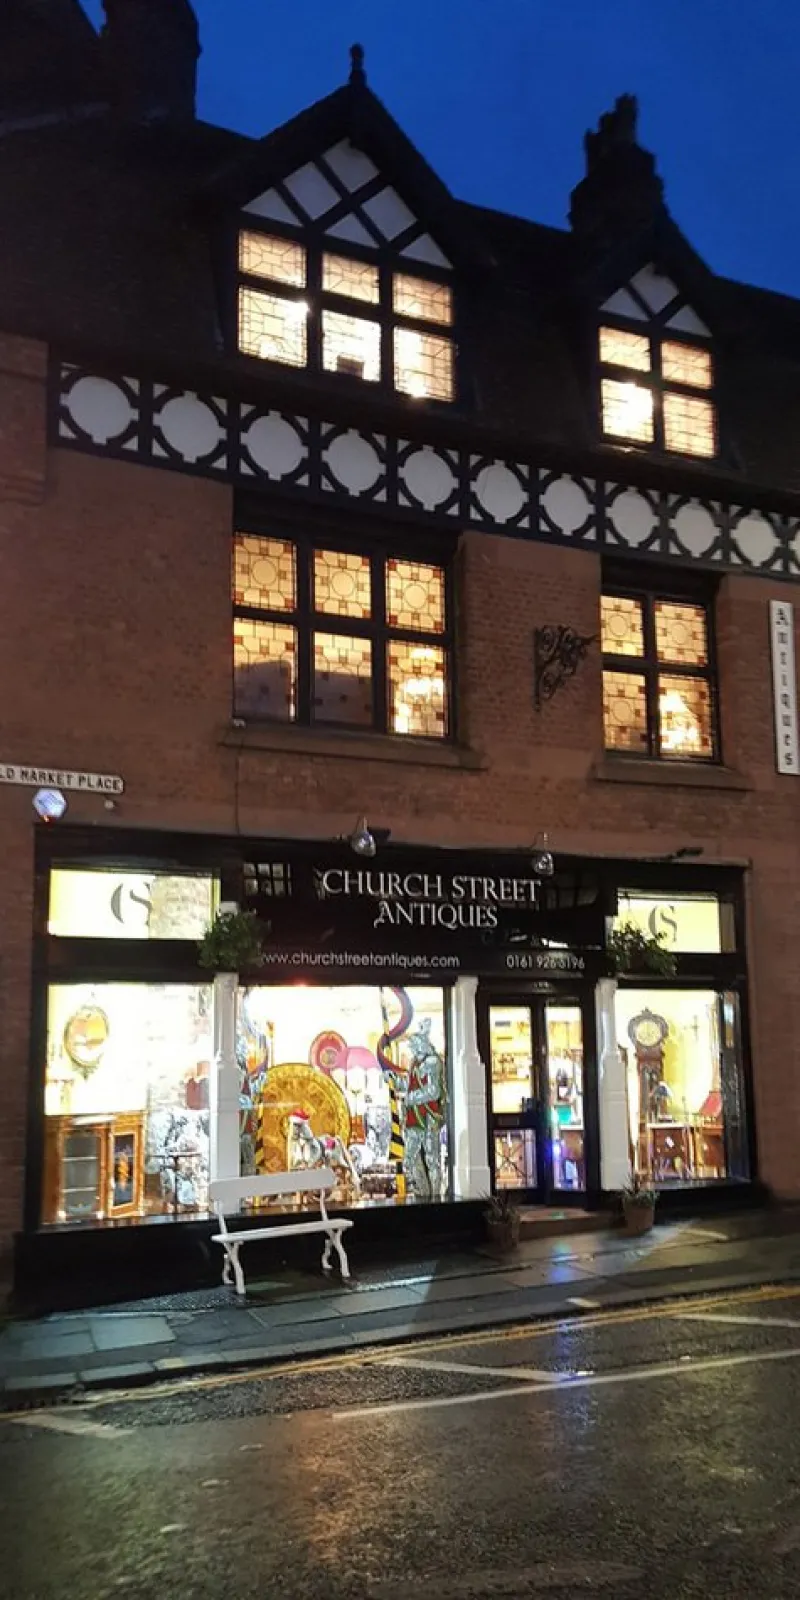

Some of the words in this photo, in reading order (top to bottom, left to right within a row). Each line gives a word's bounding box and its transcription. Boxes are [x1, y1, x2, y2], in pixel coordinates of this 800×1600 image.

[20, 769, 74, 786] MARKET
[78, 776, 120, 791] PLACE
[322, 868, 442, 897] CHURCH
[452, 875, 541, 902] STREET
[373, 900, 498, 930] ANTIQUES
[259, 950, 461, 970] www.churchstreetantiques.com
[506, 954, 533, 969] 0161
